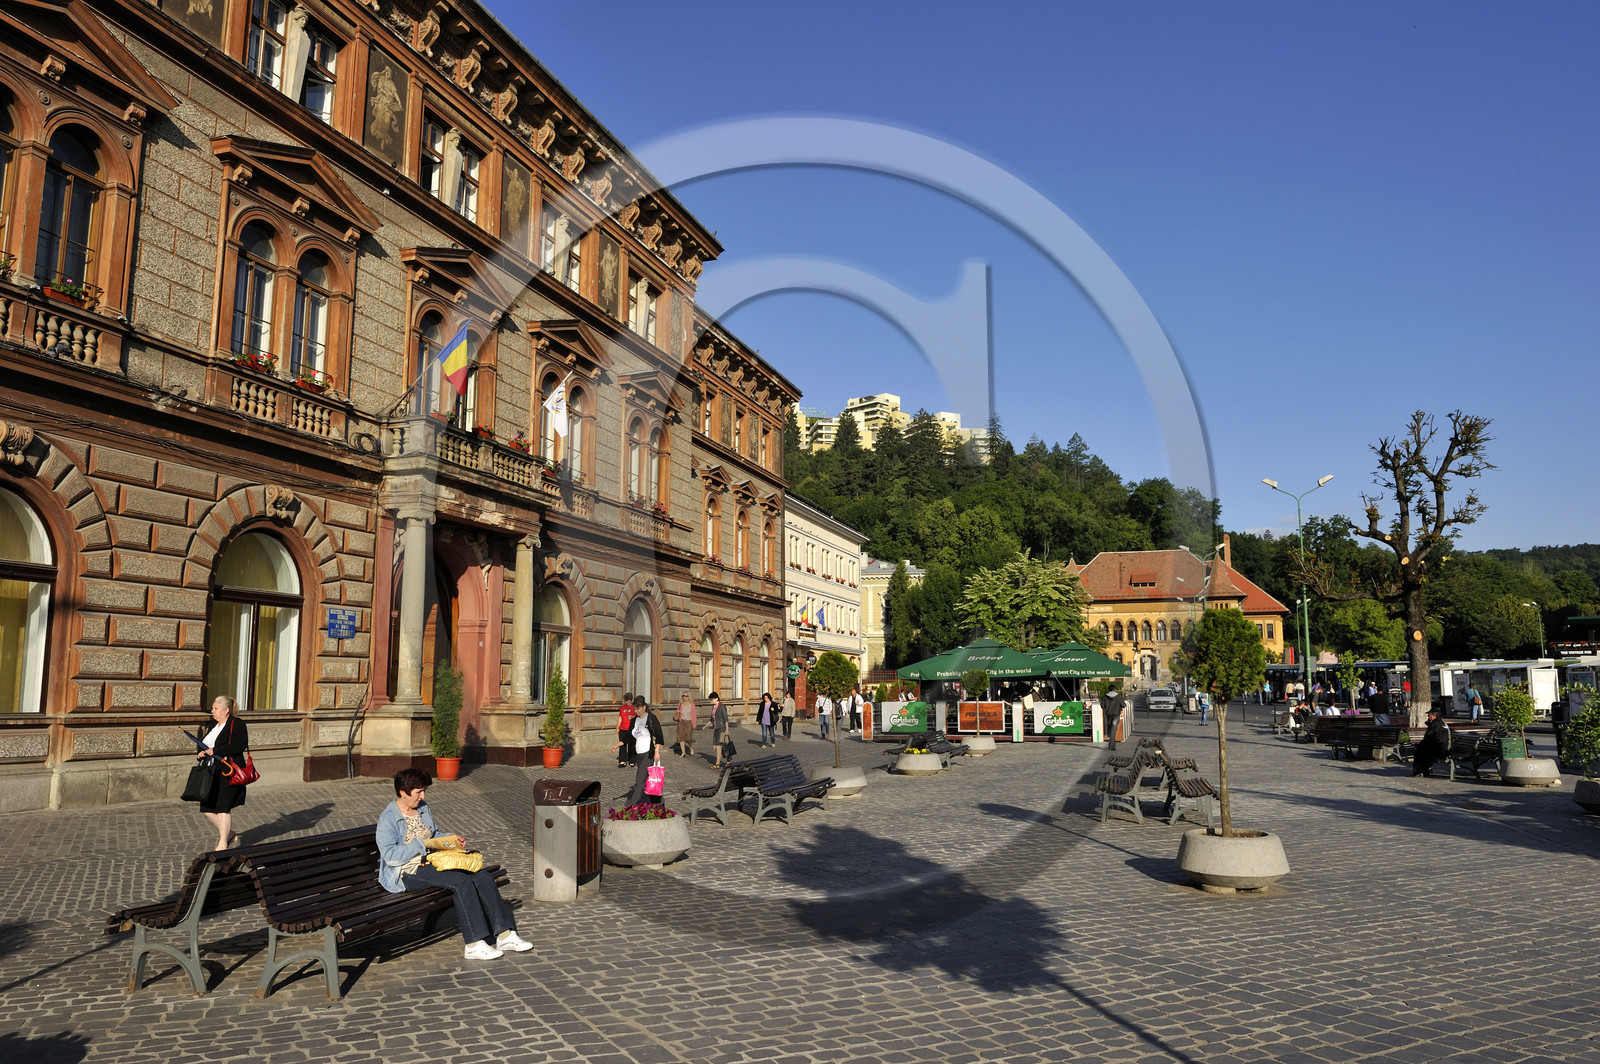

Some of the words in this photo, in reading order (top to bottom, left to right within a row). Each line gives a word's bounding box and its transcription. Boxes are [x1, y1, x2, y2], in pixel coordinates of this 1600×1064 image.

[985, 668, 998, 676] City
[890, 715, 919, 727] Carlsberg
[1043, 715, 1074, 727] Carlsberg
